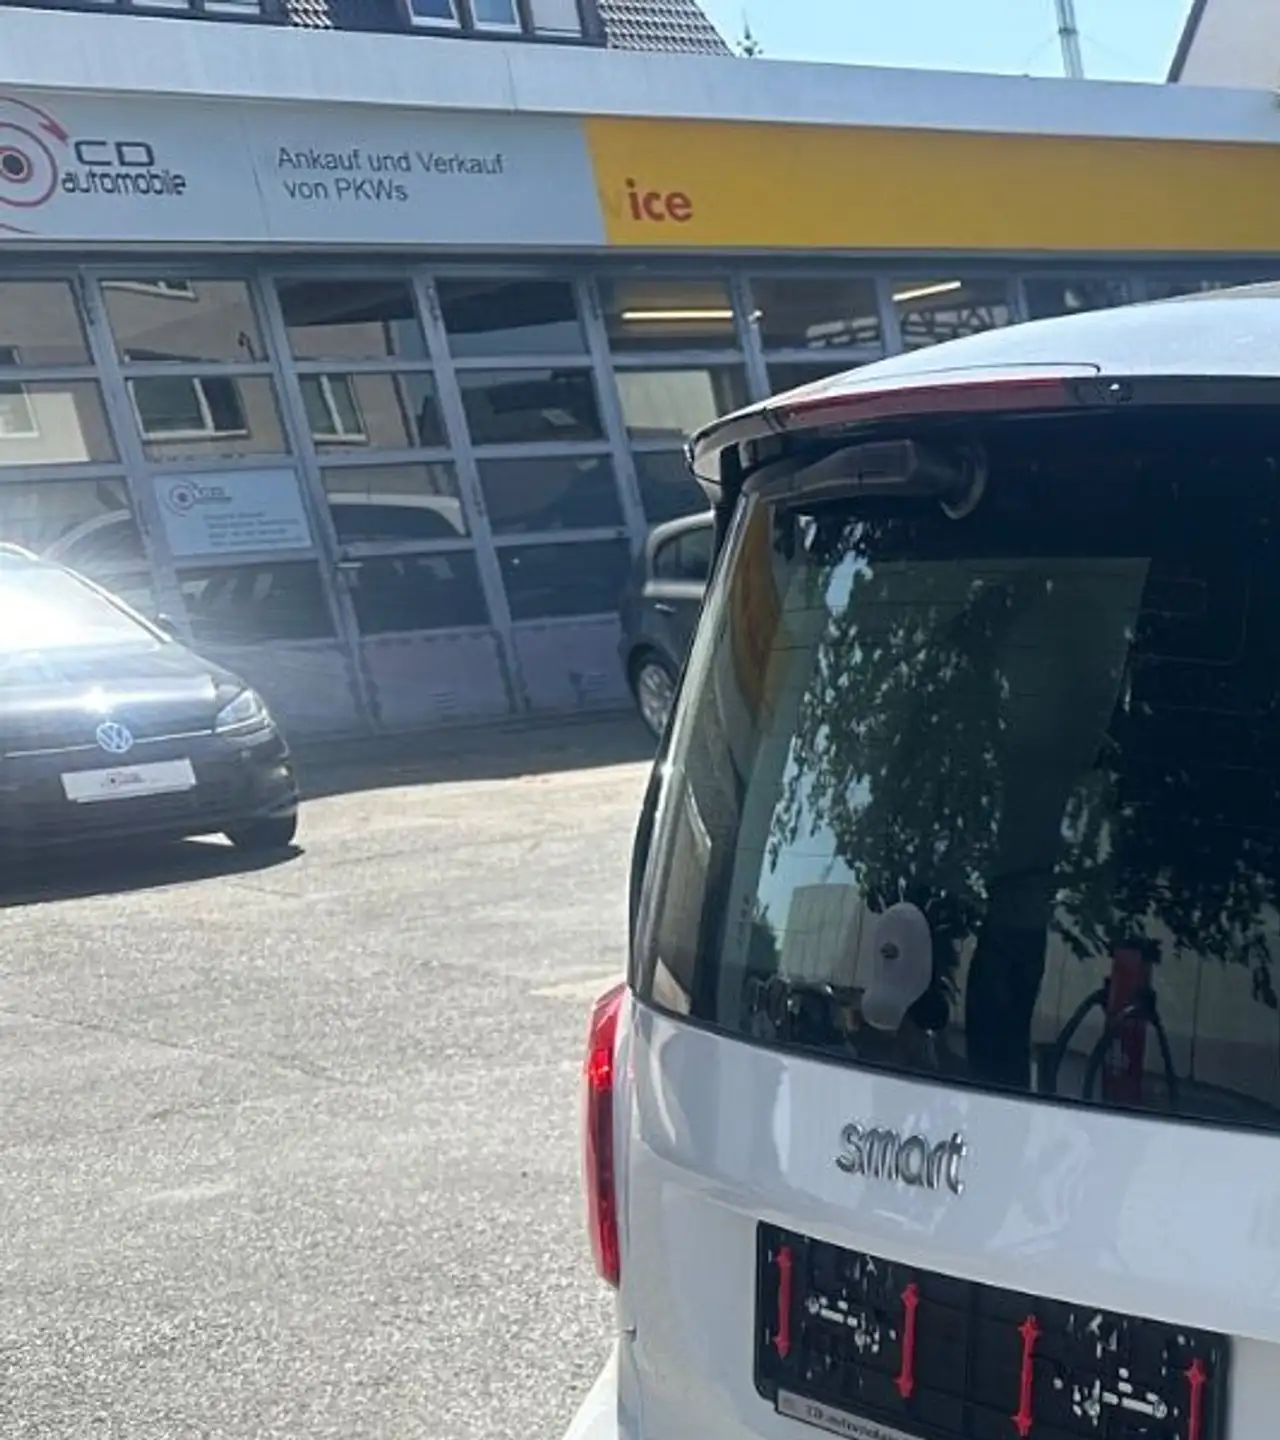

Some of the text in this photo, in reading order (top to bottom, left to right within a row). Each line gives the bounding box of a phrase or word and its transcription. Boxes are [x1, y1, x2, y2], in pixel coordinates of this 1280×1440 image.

[73, 139, 155, 167] CD
[278, 146, 504, 175] Ankauf und Verkauf
[61, 169, 187, 196] automobile
[283, 177, 409, 201] von PKWs
[625, 177, 694, 222] ice
[835, 1123, 965, 1195] smart
